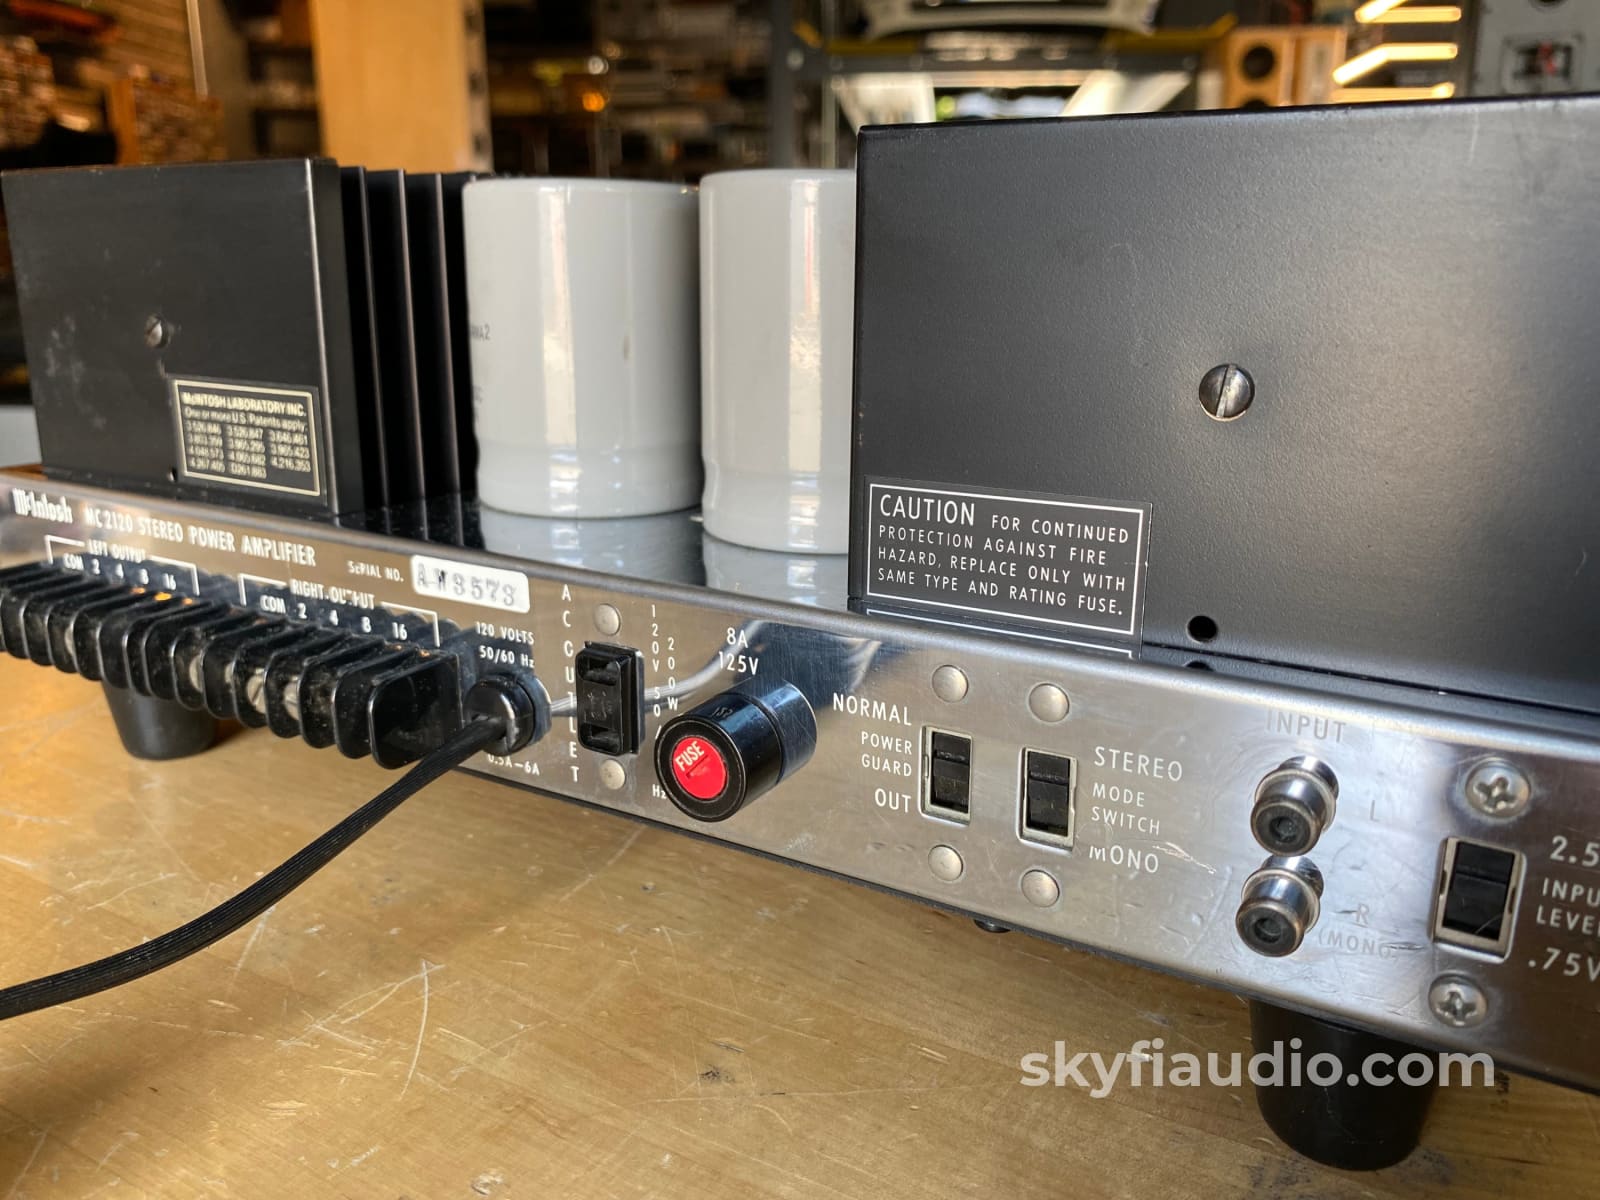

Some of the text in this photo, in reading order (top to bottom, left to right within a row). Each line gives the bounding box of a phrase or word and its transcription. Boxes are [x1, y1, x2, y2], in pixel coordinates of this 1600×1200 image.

[880, 494, 1129, 543] CAUTION FOR CONTINUED
[137, 516, 184, 543] STEREO
[187, 524, 236, 553] POWER
[241, 534, 317, 567] AMPLIFIER
[879, 525, 1107, 565] PROTECTION AGAINST FIRE
[161, 573, 177, 591] 16
[348, 560, 404, 582] SERIAL NO.
[878, 546, 1126, 592] HAZARD, REPLACE ONLY WITH
[289, 578, 325, 600] RIGHT
[878, 568, 1123, 616] SAME TYPE AND RATING FUSE.
[260, 594, 408, 641] COM 2 4 8 16
[476, 621, 535, 645] 120 VOLTS
[727, 627, 748, 648] 8A
[479, 645, 515, 664] 50/60
[718, 651, 759, 676] 125V
[833, 692, 912, 726] NORMAL
[1266, 710, 1348, 744] INPUT
[674, 740, 705, 772] FUSE
[861, 731, 913, 755] POWER
[861, 754, 913, 777] GUARD
[1094, 746, 1183, 782] STEREO
[874, 788, 912, 813] OUT
[1092, 783, 1146, 807] MODE
[1091, 806, 1161, 836] SWITCH
[1089, 845, 1159, 874] MONO
[1536, 904, 1600, 938] LEVE
[1528, 947, 1600, 982] .75V
